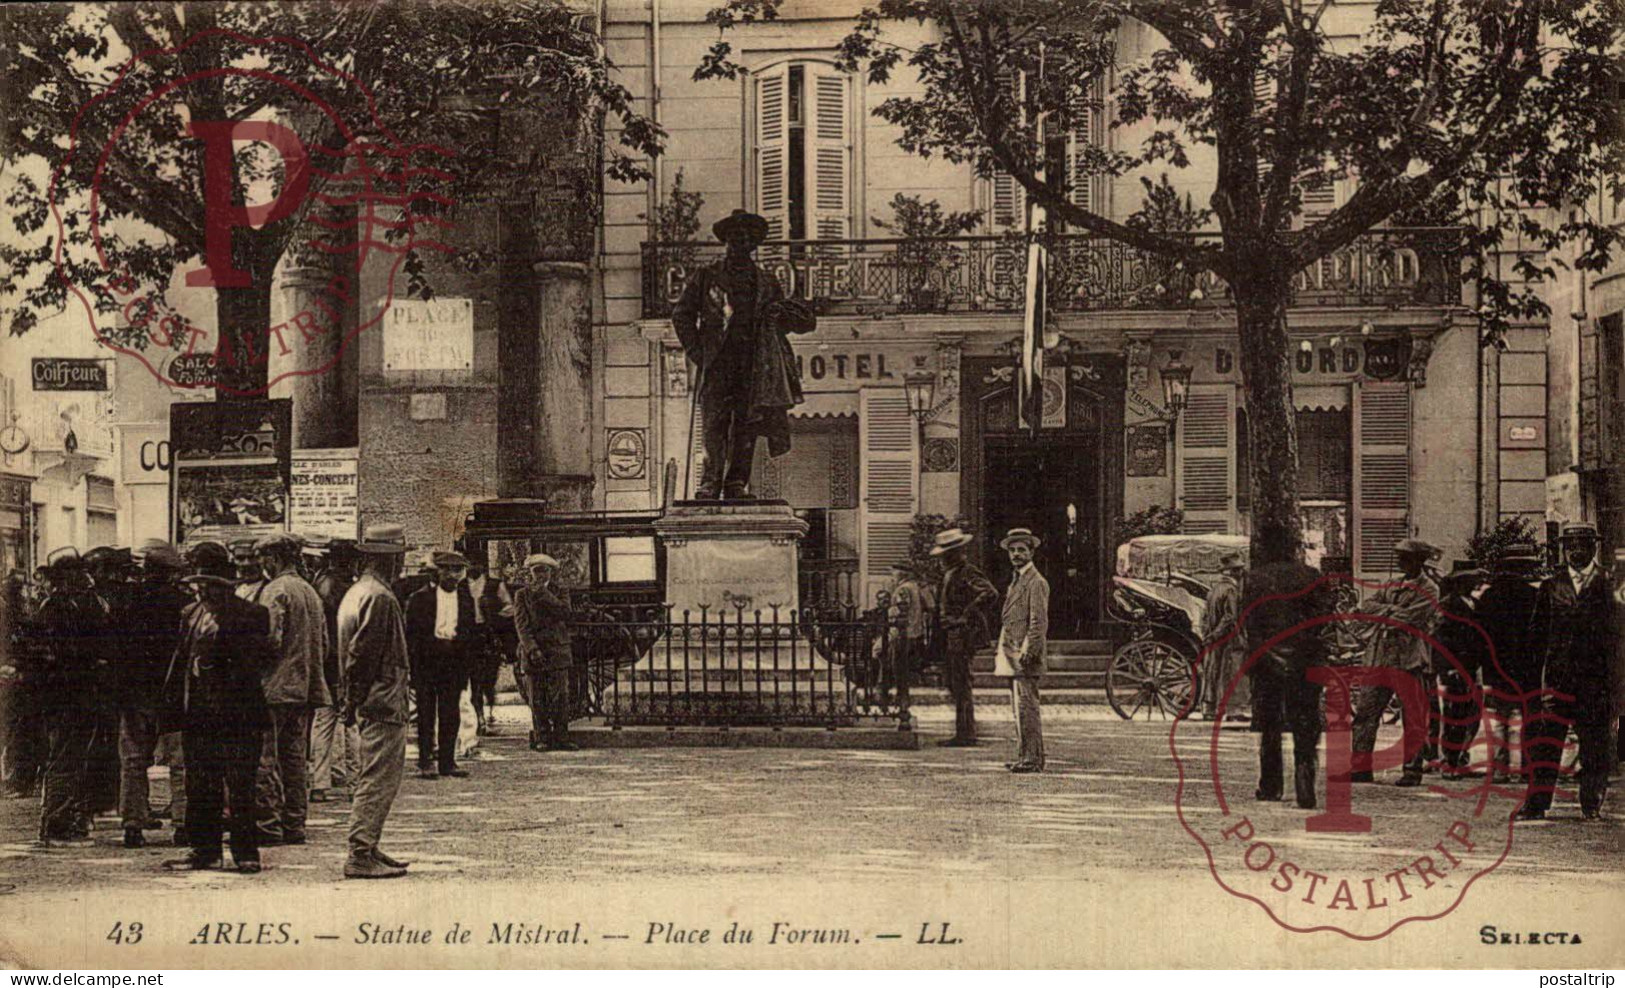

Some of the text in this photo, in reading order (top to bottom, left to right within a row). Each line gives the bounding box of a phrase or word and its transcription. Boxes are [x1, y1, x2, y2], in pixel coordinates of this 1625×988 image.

[393, 306, 465, 324] PLACE
[174, 357, 217, 371] SALO
[1298, 346, 1359, 375] ORD
[140, 440, 171, 471] CO
